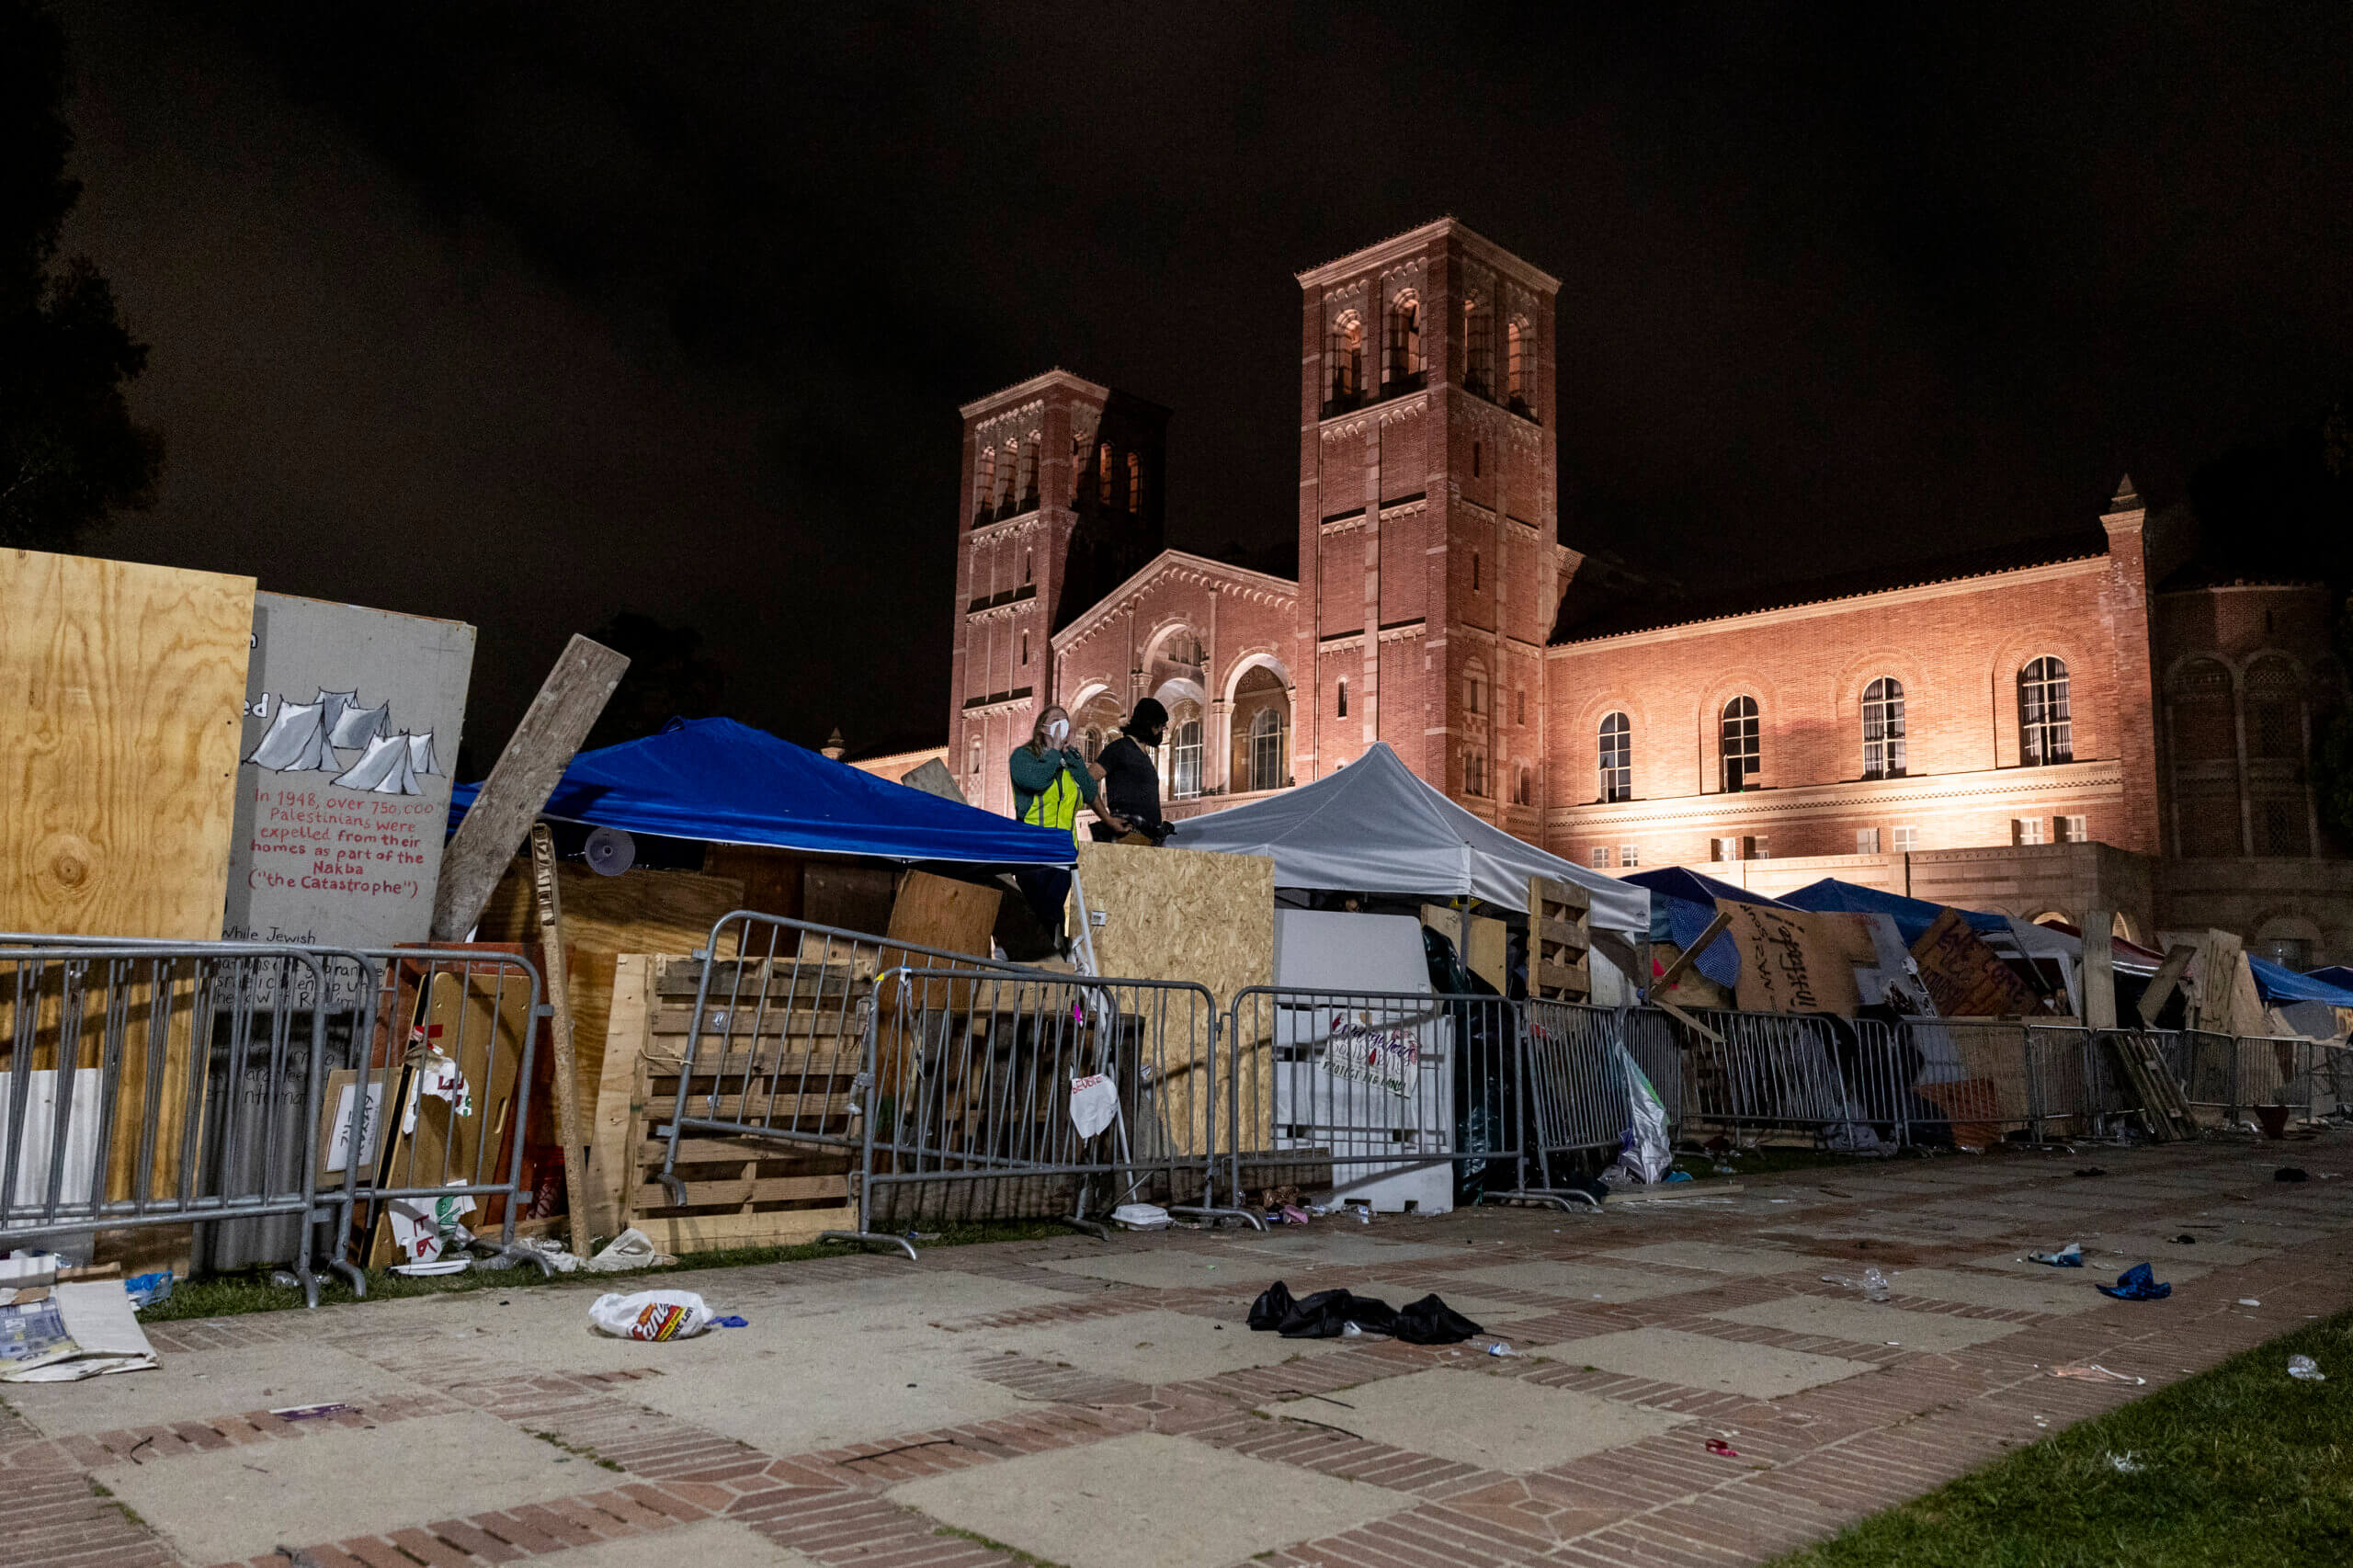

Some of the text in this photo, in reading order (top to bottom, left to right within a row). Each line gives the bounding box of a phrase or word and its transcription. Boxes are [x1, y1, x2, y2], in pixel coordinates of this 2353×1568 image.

[255, 788, 269, 802] In
[278, 790, 320, 810] 1948,
[326, 798, 366, 810] over
[270, 807, 416, 833] Palestinians were
[260, 826, 421, 848] expelled from their
[250, 840, 425, 864] homes as part of the
[313, 860, 364, 875] Nakba
[248, 868, 418, 898] ("the Catastrophe")
[267, 926, 316, 945] Jewish
